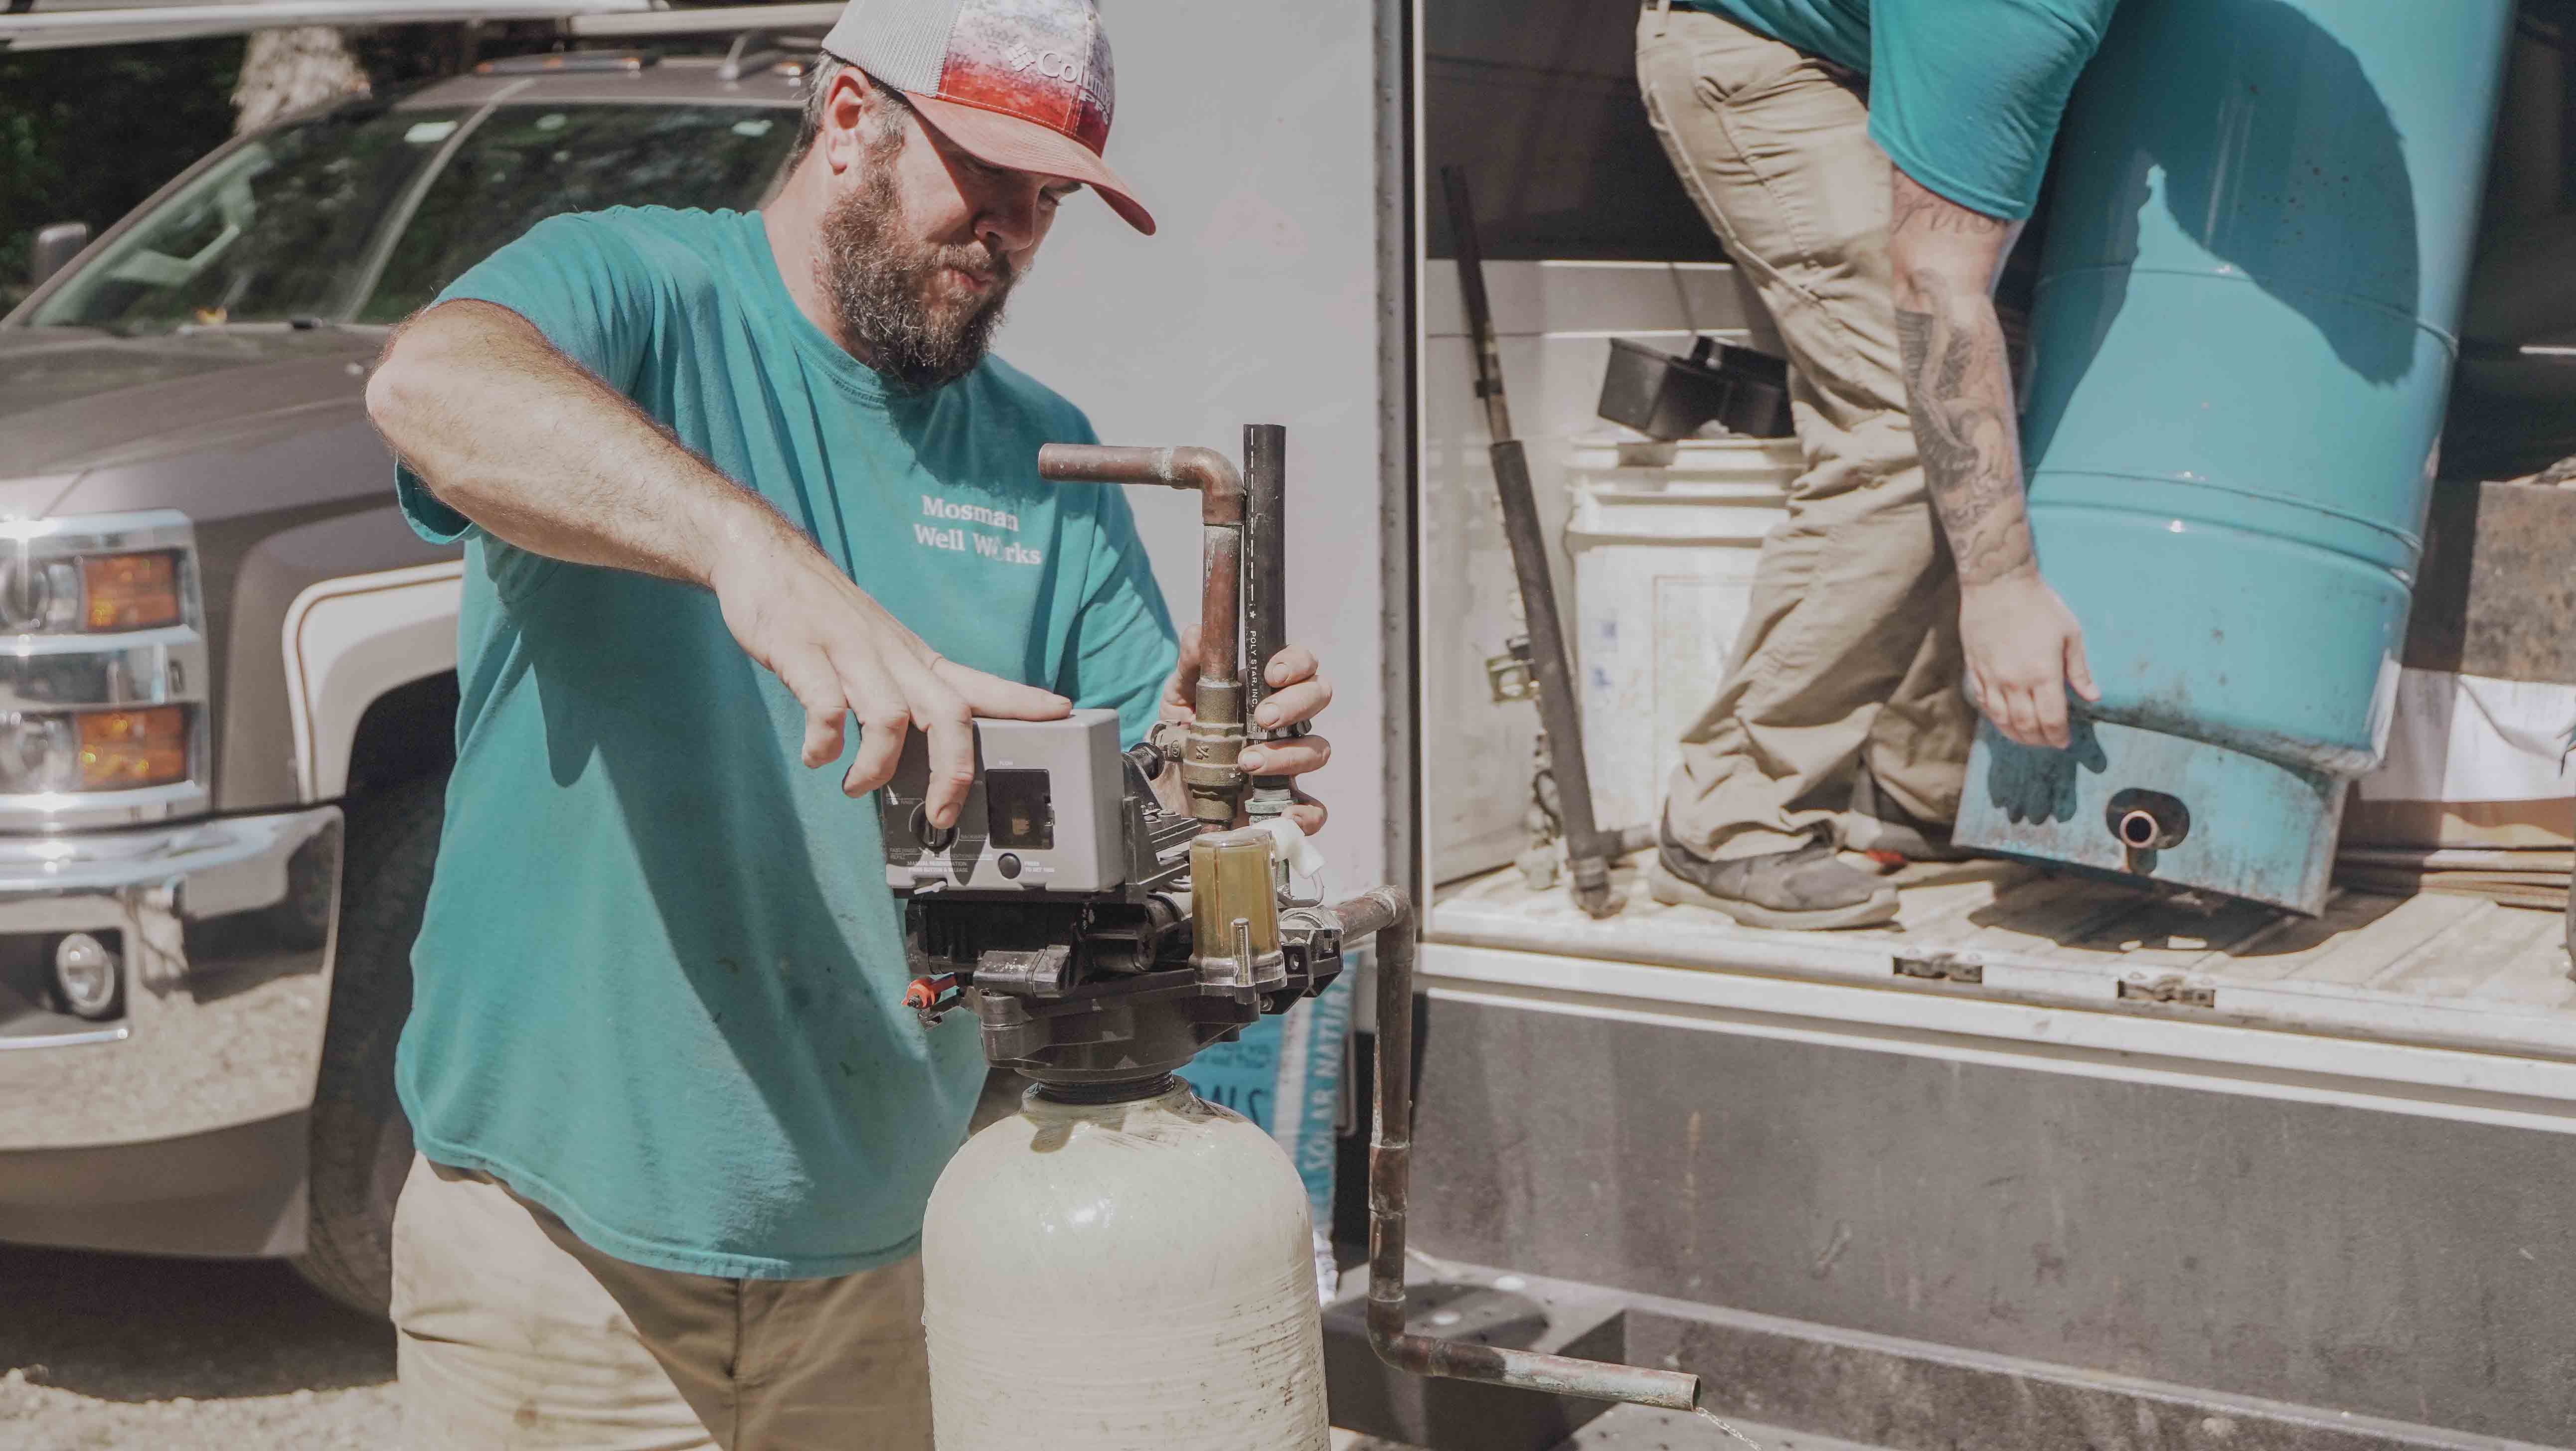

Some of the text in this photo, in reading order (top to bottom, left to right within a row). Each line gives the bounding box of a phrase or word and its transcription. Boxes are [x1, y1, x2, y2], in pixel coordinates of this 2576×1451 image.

[1037, 51, 1111, 114] Columb
[921, 494, 1020, 532] Mosman
[913, 523, 1042, 565] Well Works
[1302, 1088, 1335, 1171] SOLAR
